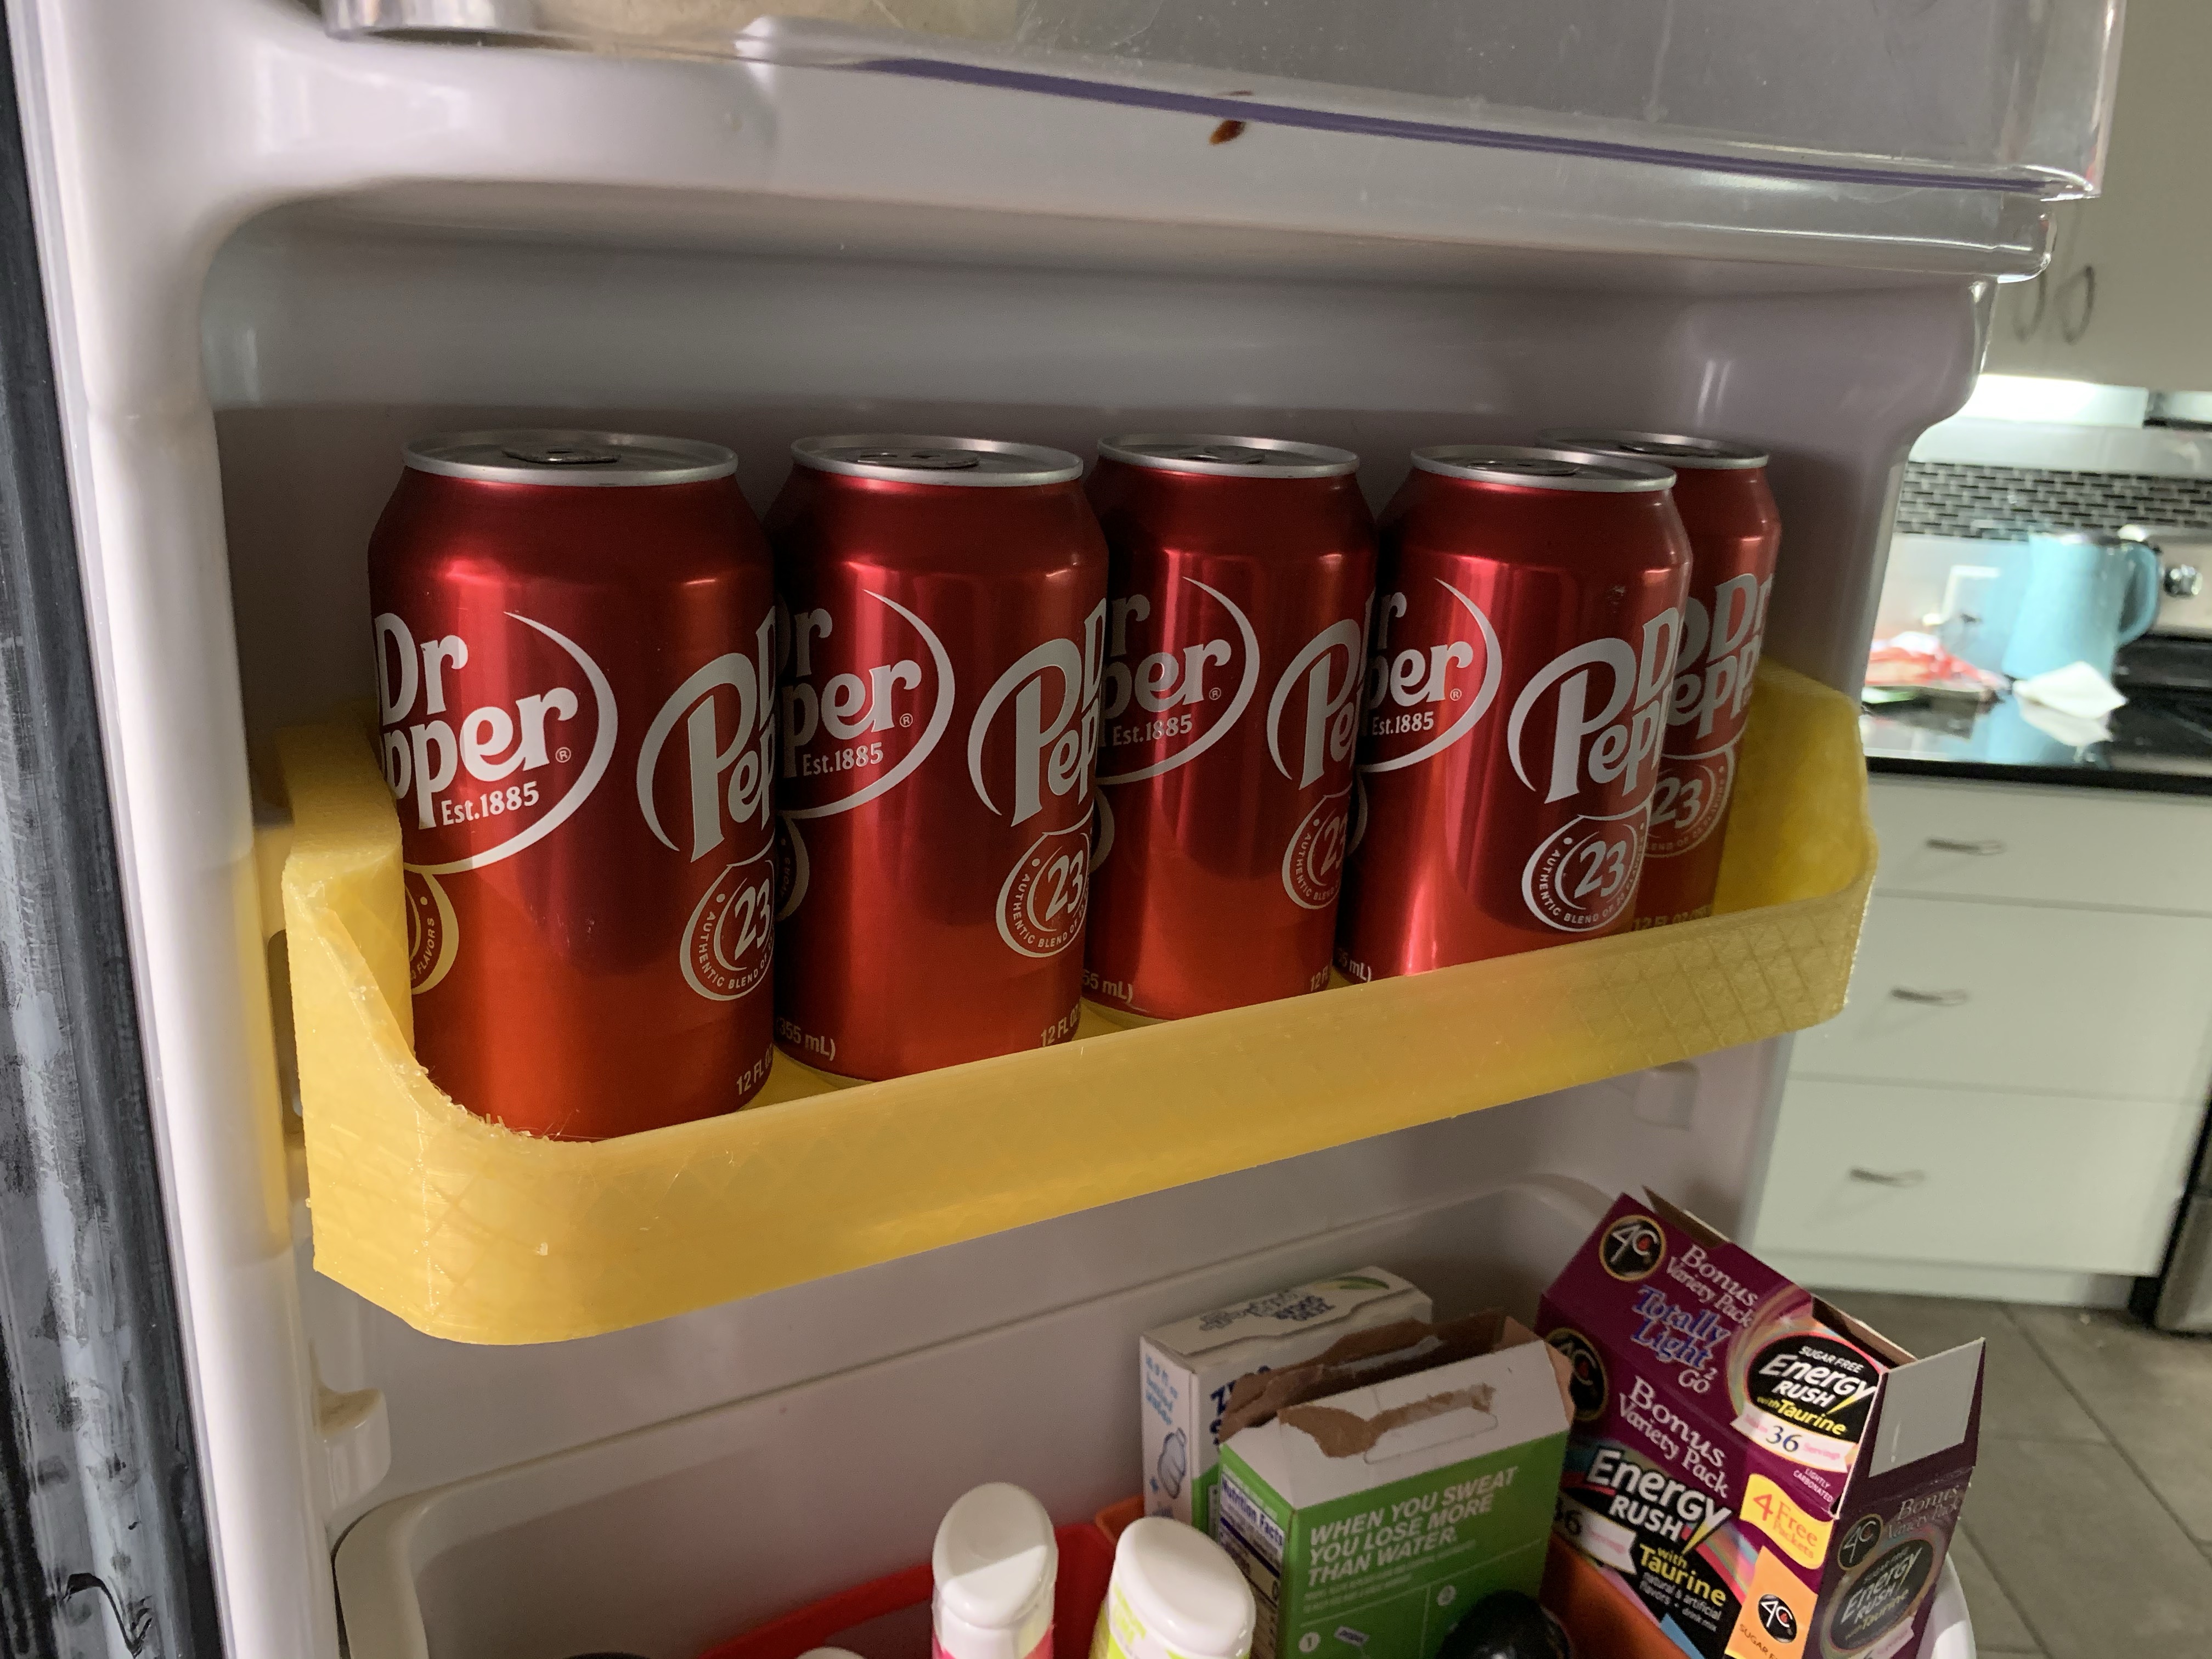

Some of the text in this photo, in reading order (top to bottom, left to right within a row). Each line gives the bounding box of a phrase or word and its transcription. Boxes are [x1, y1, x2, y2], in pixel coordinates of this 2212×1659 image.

[1111, 594, 1150, 657] r
[1379, 592, 1407, 650] r
[374, 613, 469, 725] Dr
[1361, 641, 1474, 736] per
[1634, 607, 1679, 711] D
[1666, 596, 1761, 740] epp
[781, 660, 922, 778] per
[1099, 639, 1232, 747] per
[1507, 637, 1671, 805] Pep
[384, 687, 579, 830] pper
[636, 653, 776, 862] Pep
[968, 639, 1099, 827] Pep
[1649, 777, 1703, 828] 23
[1046, 850, 1083, 922] 23
[1296, 833, 1312, 897] AUTHENTIC
[1539, 849, 1561, 916] AUTHENTIC
[1564, 913, 1599, 924] BLEND
[1602, 904, 1615, 918] OF
[1574, 840, 1627, 899] 23
[735, 878, 770, 960] 23
[1013, 874, 1035, 944] AUTHENTIC
[1038, 932, 1068, 948] BLEND
[417, 918, 435, 974] FLAVORS
[698, 911, 724, 988] AUTHENTIC
[728, 968, 758, 989] BLEND
[1311, 972, 1321, 992] 12
[1041, 1025, 1056, 1048] 12
[1058, 1016, 1069, 1039] FL
[736, 1071, 751, 1096] 12
[1610, 1224, 1660, 1262] 4C
[1666, 1256, 1754, 1328] Variety Pack
[1681, 1244, 1758, 1306] Bonus
[1630, 1317, 1714, 1370] Light
[1631, 1284, 1732, 1350] Totally
[1798, 1345, 1864, 1374] SUGAR FREE
[1628, 1374, 1726, 1468] Bonus
[1771, 1380, 1837, 1408] RUSH
[1776, 1399, 1847, 1436] Taurine
[1618, 1392, 1729, 1499] Variety Pack
[1765, 1425, 1803, 1453] 36
[1310, 1507, 1385, 1546] WHEN
[1391, 1491, 1438, 1522] YOU
[1441, 1465, 1519, 1506] SWEAT
[1792, 1469, 1834, 1503] CARBONATED
[1804, 1468, 1831, 1489] LIGHTLY
[1897, 1487, 1960, 1520] Bonus
[1222, 1476, 1257, 1523] Nutrition
[1260, 1512, 1283, 1547] Facts
[1310, 1536, 1359, 1567] YOU
[1364, 1516, 1424, 1551] LOSE
[1427, 1493, 1494, 1530] MORE
[1607, 1494, 1684, 1542] RUSH
[1753, 1493, 1819, 1548] 4 Free
[1772, 1519, 1815, 1560] Packets
[1843, 1520, 1876, 1564] 4C
[1308, 1553, 1372, 1588] THAN
[1639, 1542, 1727, 1607] Taurine
[1657, 1547, 1688, 1569] with
[1738, 1623, 1769, 1657] SUGAR
[1760, 1600, 1794, 1629] 4C
